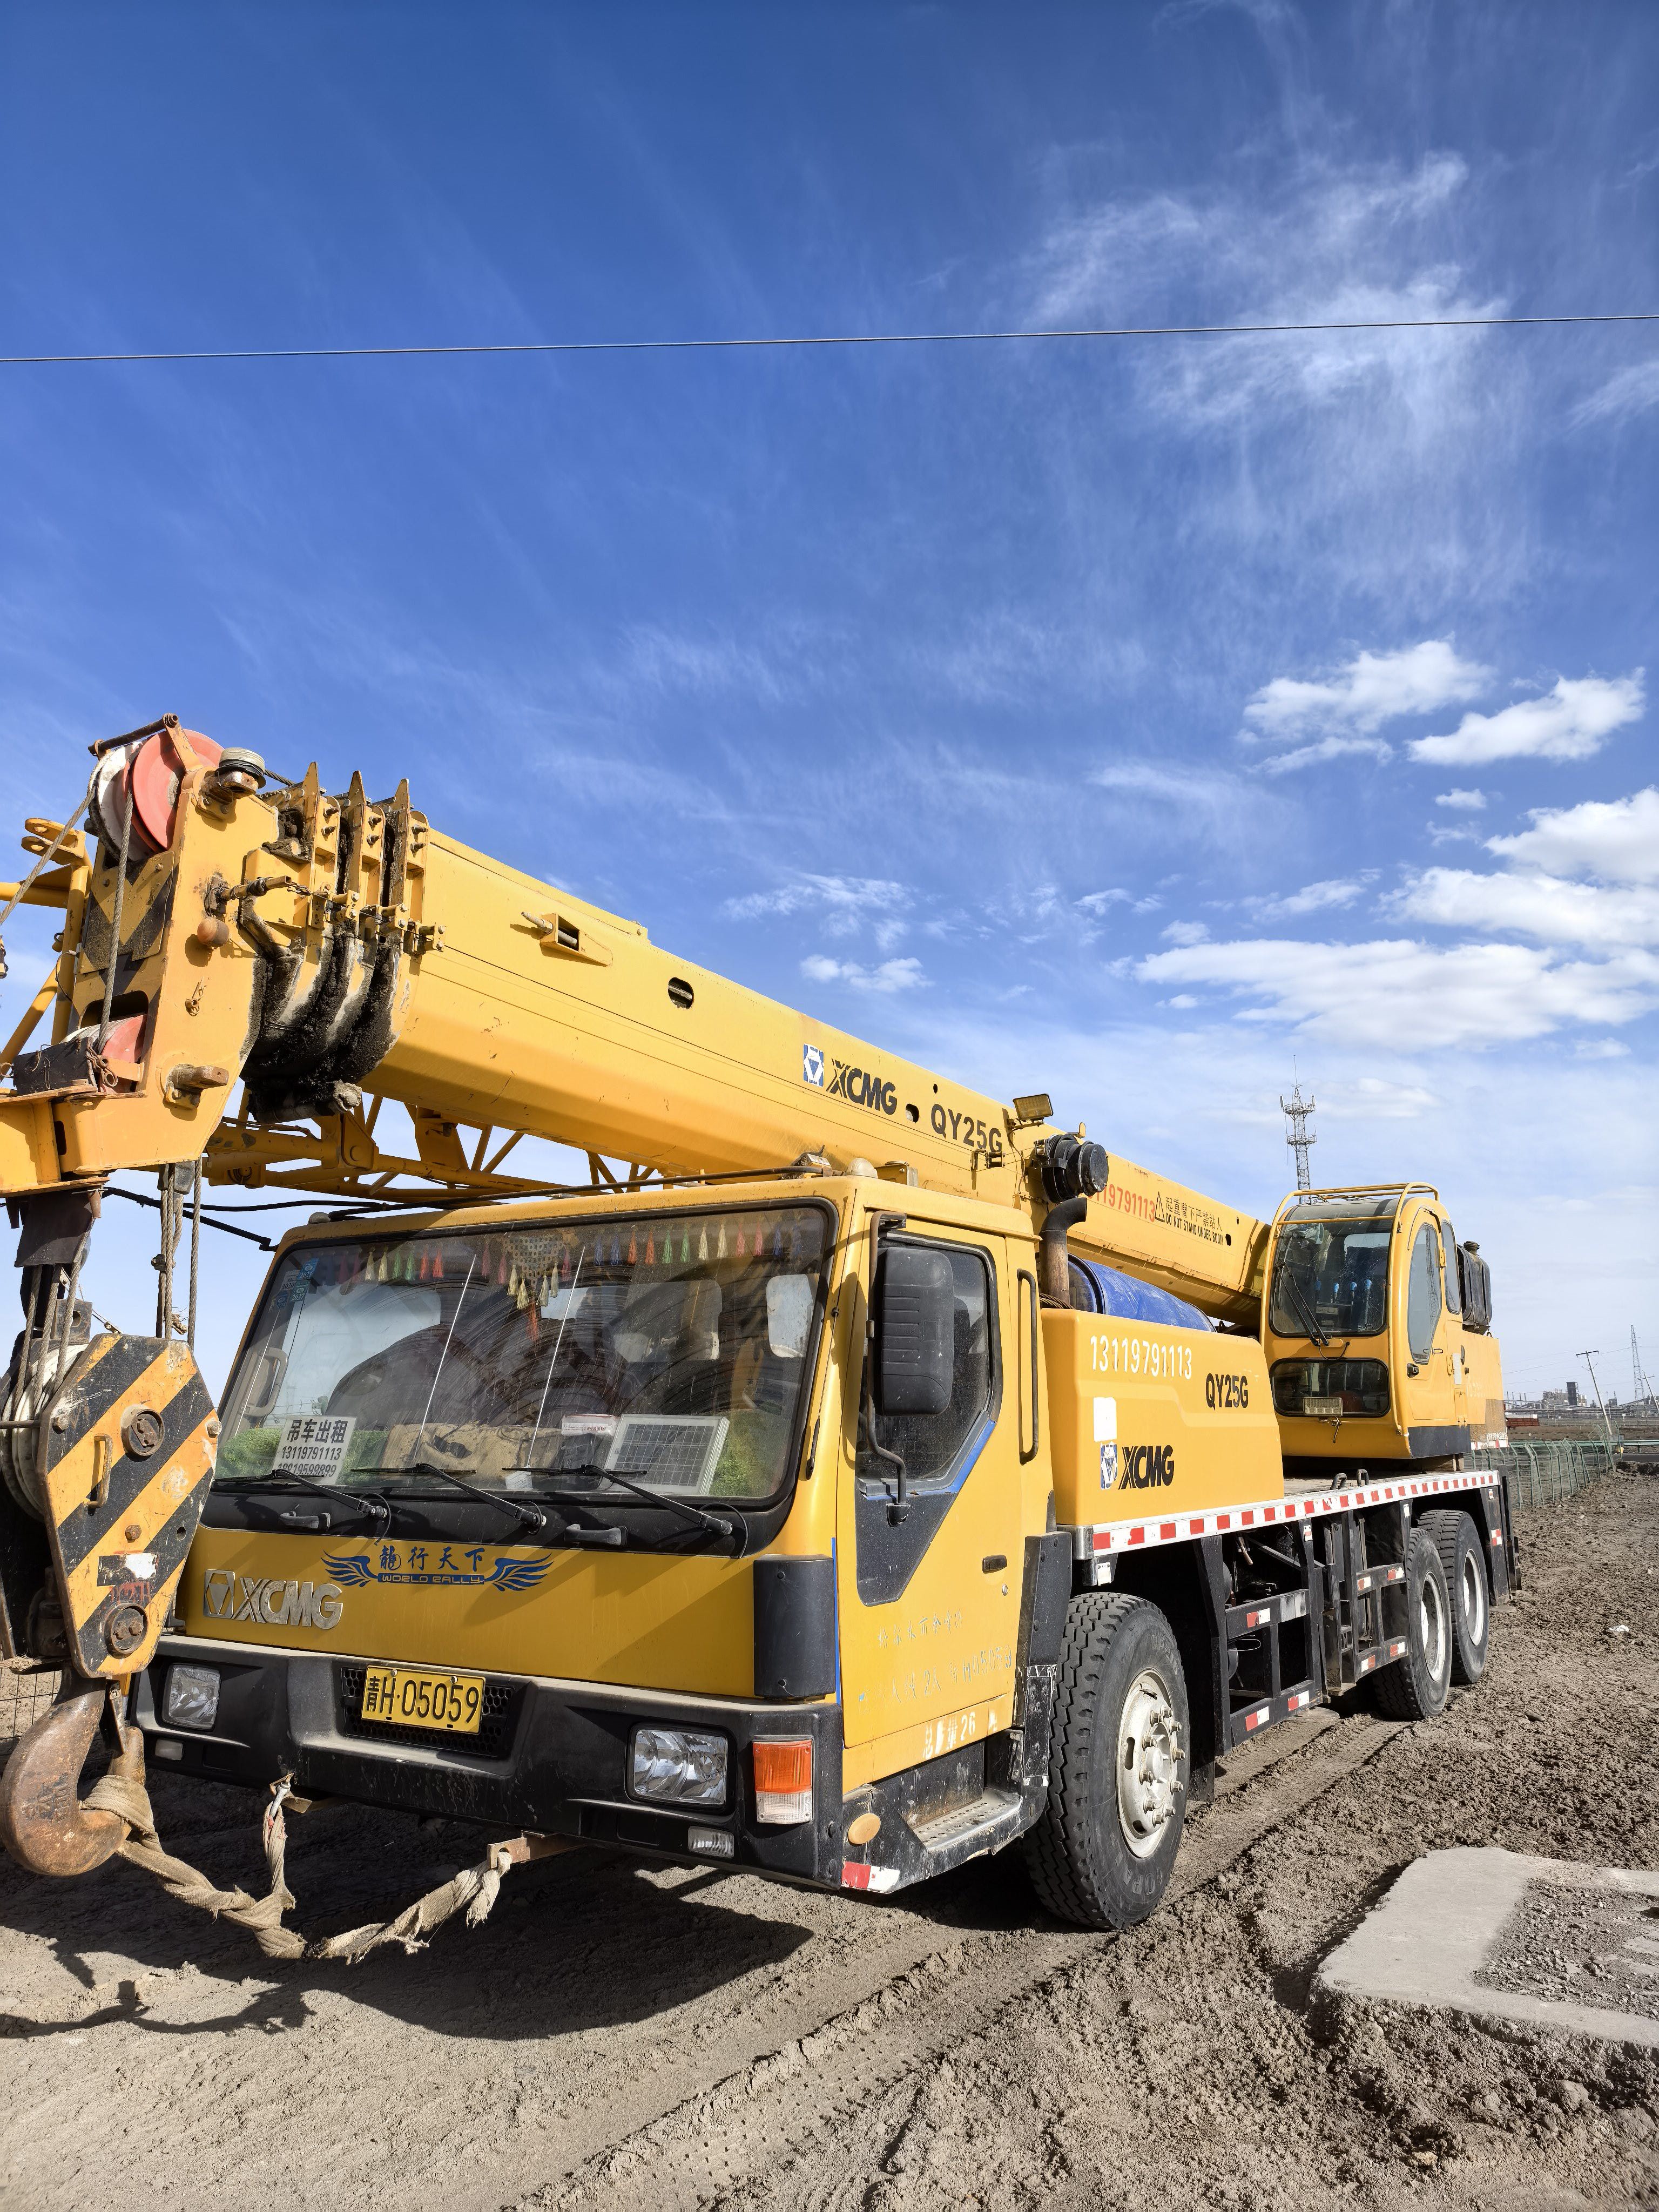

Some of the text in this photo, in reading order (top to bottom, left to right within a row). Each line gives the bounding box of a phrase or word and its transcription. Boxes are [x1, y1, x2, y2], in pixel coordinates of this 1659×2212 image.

[826, 1058, 898, 1115] XCMG
[932, 1104, 1002, 1152] QY25G
[1166, 1197, 1222, 1231] 起重臂下严禁站人
[1166, 1212, 1172, 1225] DO
[1174, 1215, 1182, 1230] NOT
[1184, 1219, 1197, 1235] STAND
[1198, 1225, 1211, 1241] UNDER
[1090, 1335, 1192, 1380] 13119791113
[1205, 1373, 1249, 1411] QY25G
[287, 1419, 348, 1444] 吊车出租
[282, 1446, 342, 1460] 13119791113
[1118, 1445, 1175, 1490] XCMG
[382, 1575, 481, 1584] WORLD RALLY
[231, 1577, 343, 1630] XCMG
